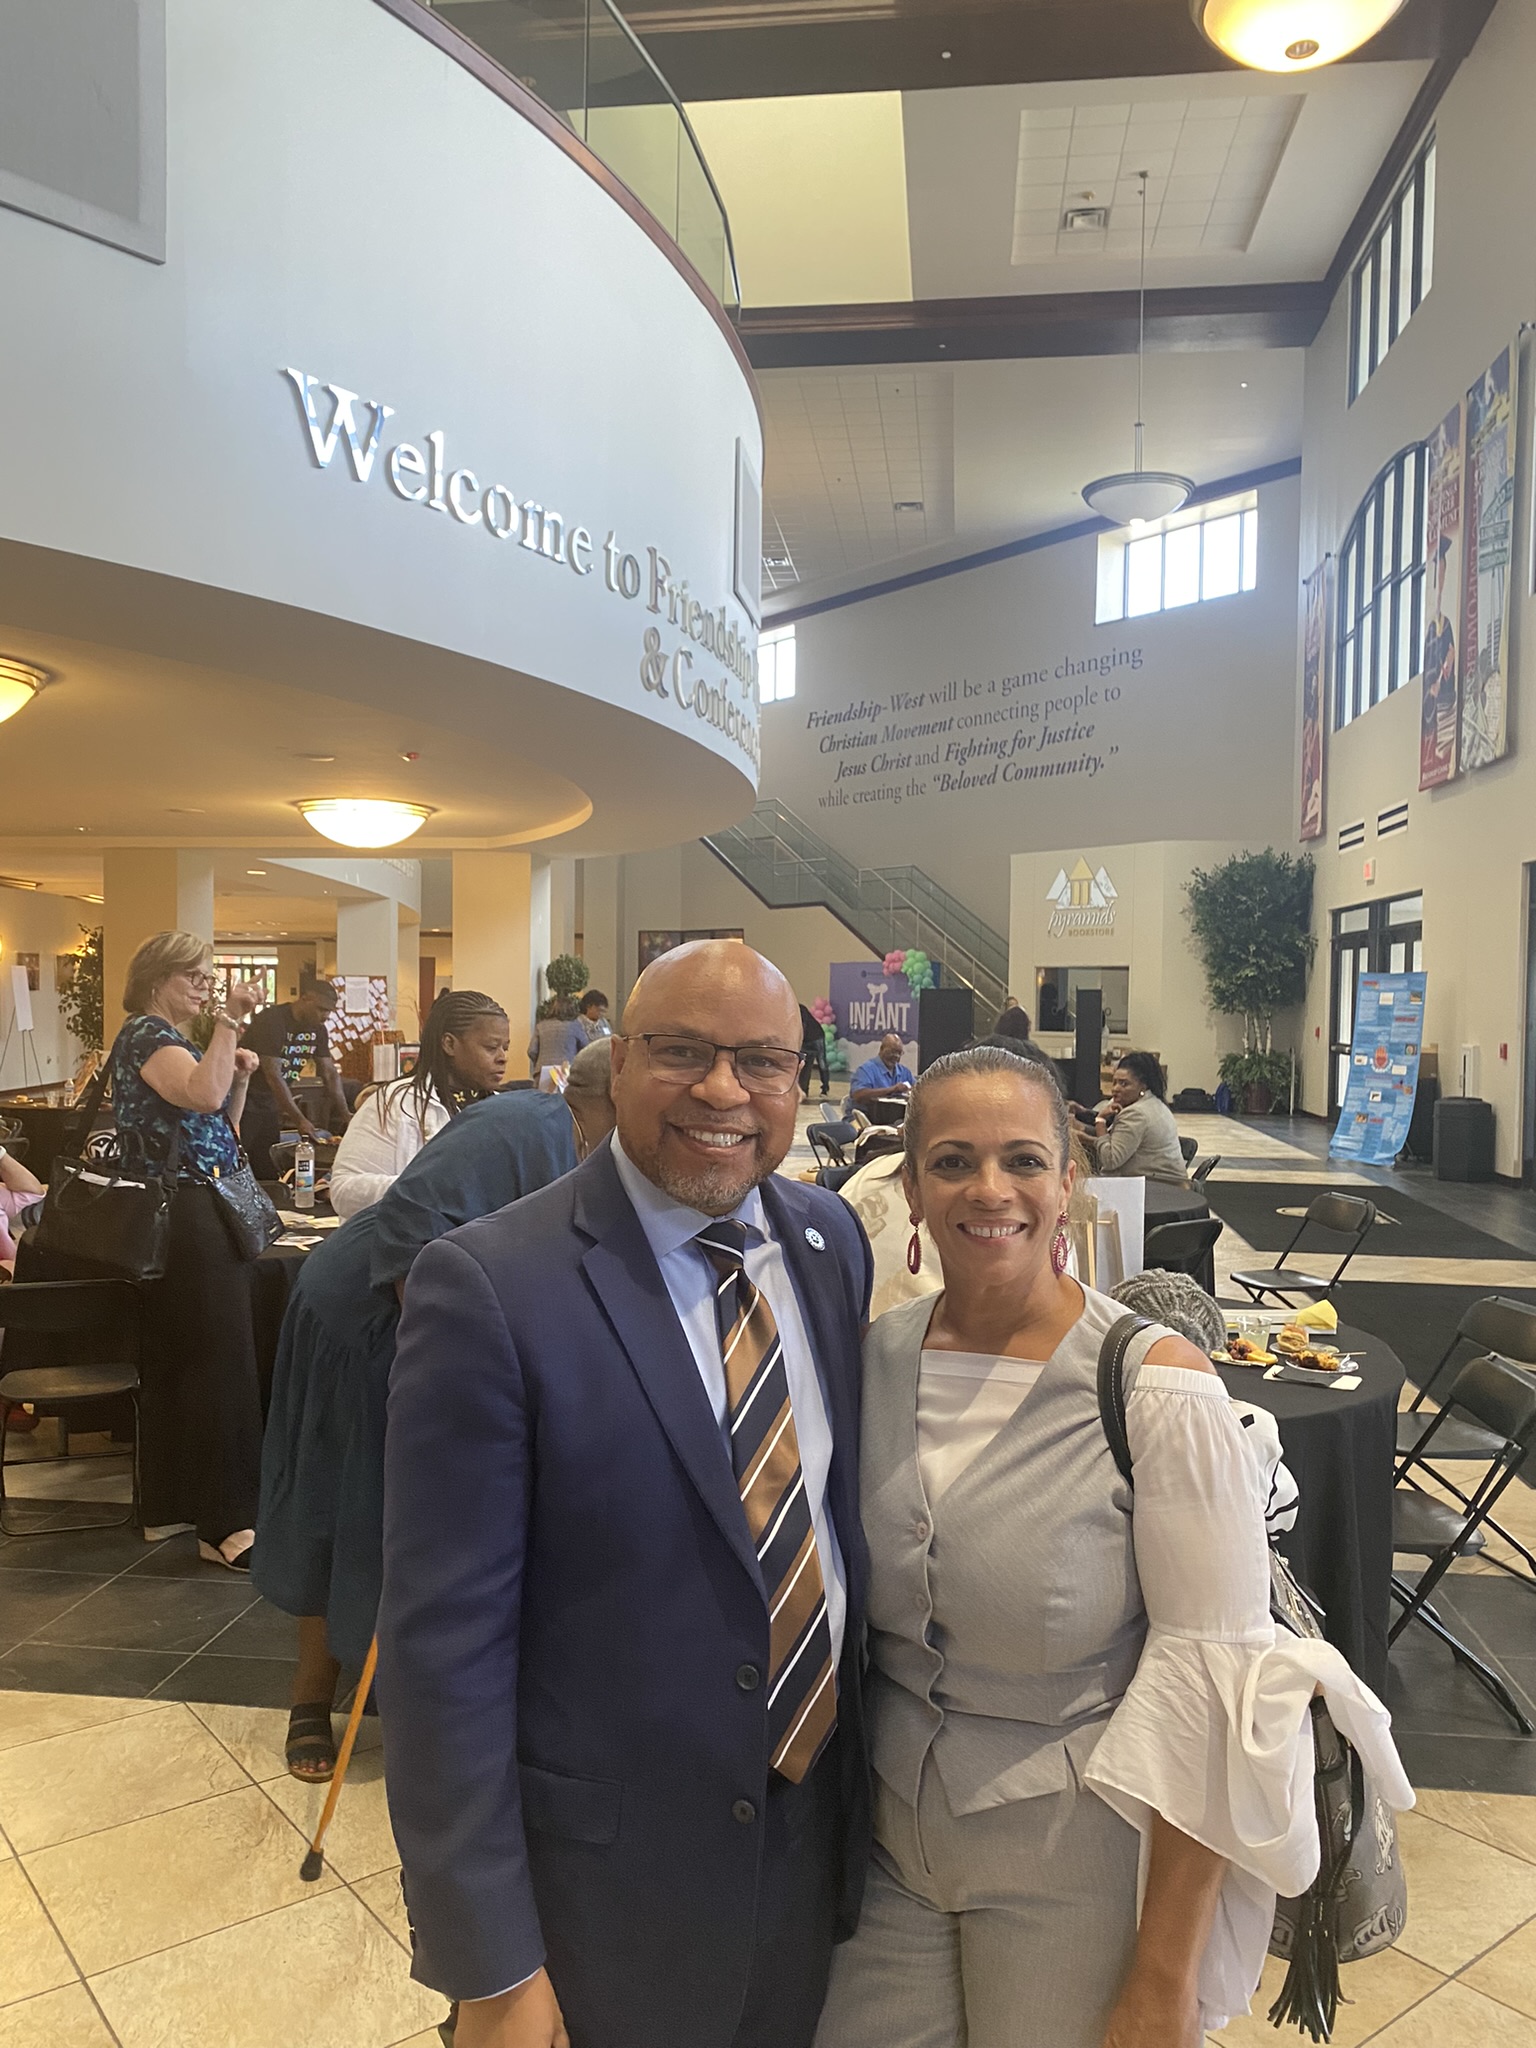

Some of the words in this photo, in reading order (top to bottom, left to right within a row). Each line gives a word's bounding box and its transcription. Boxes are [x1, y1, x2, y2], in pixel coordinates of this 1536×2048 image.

[280, 367, 594, 576] Welcome
[603, 530, 641, 600] to
[646, 546, 754, 699] Friendship
[640, 626, 670, 699] &
[806, 692, 926, 729] Friendship-West
[928, 681, 957, 705] will
[963, 678, 982, 699] be
[987, 680, 996, 694] a
[1001, 668, 1049, 697] game
[1054, 648, 1144, 677] changing
[819, 731, 878, 754] Christian
[880, 716, 955, 744] Movement
[956, 701, 1040, 730] connecting
[1044, 685, 1098, 720] people
[1104, 686, 1121, 703] to
[834, 761, 867, 783] Jesus
[871, 752, 913, 773] Christ
[914, 744, 940, 767] and
[944, 734, 1009, 766] Fighting
[1007, 729, 1037, 758] for
[1035, 721, 1096, 752] Justice
[818, 788, 849, 808] while
[852, 783, 903, 805] creating
[905, 778, 927, 797] the
[1047, 900, 1116, 938] pyramids
[1068, 927, 1115, 937] BOOKSTORE
[849, 1001, 911, 1032] INFANT
